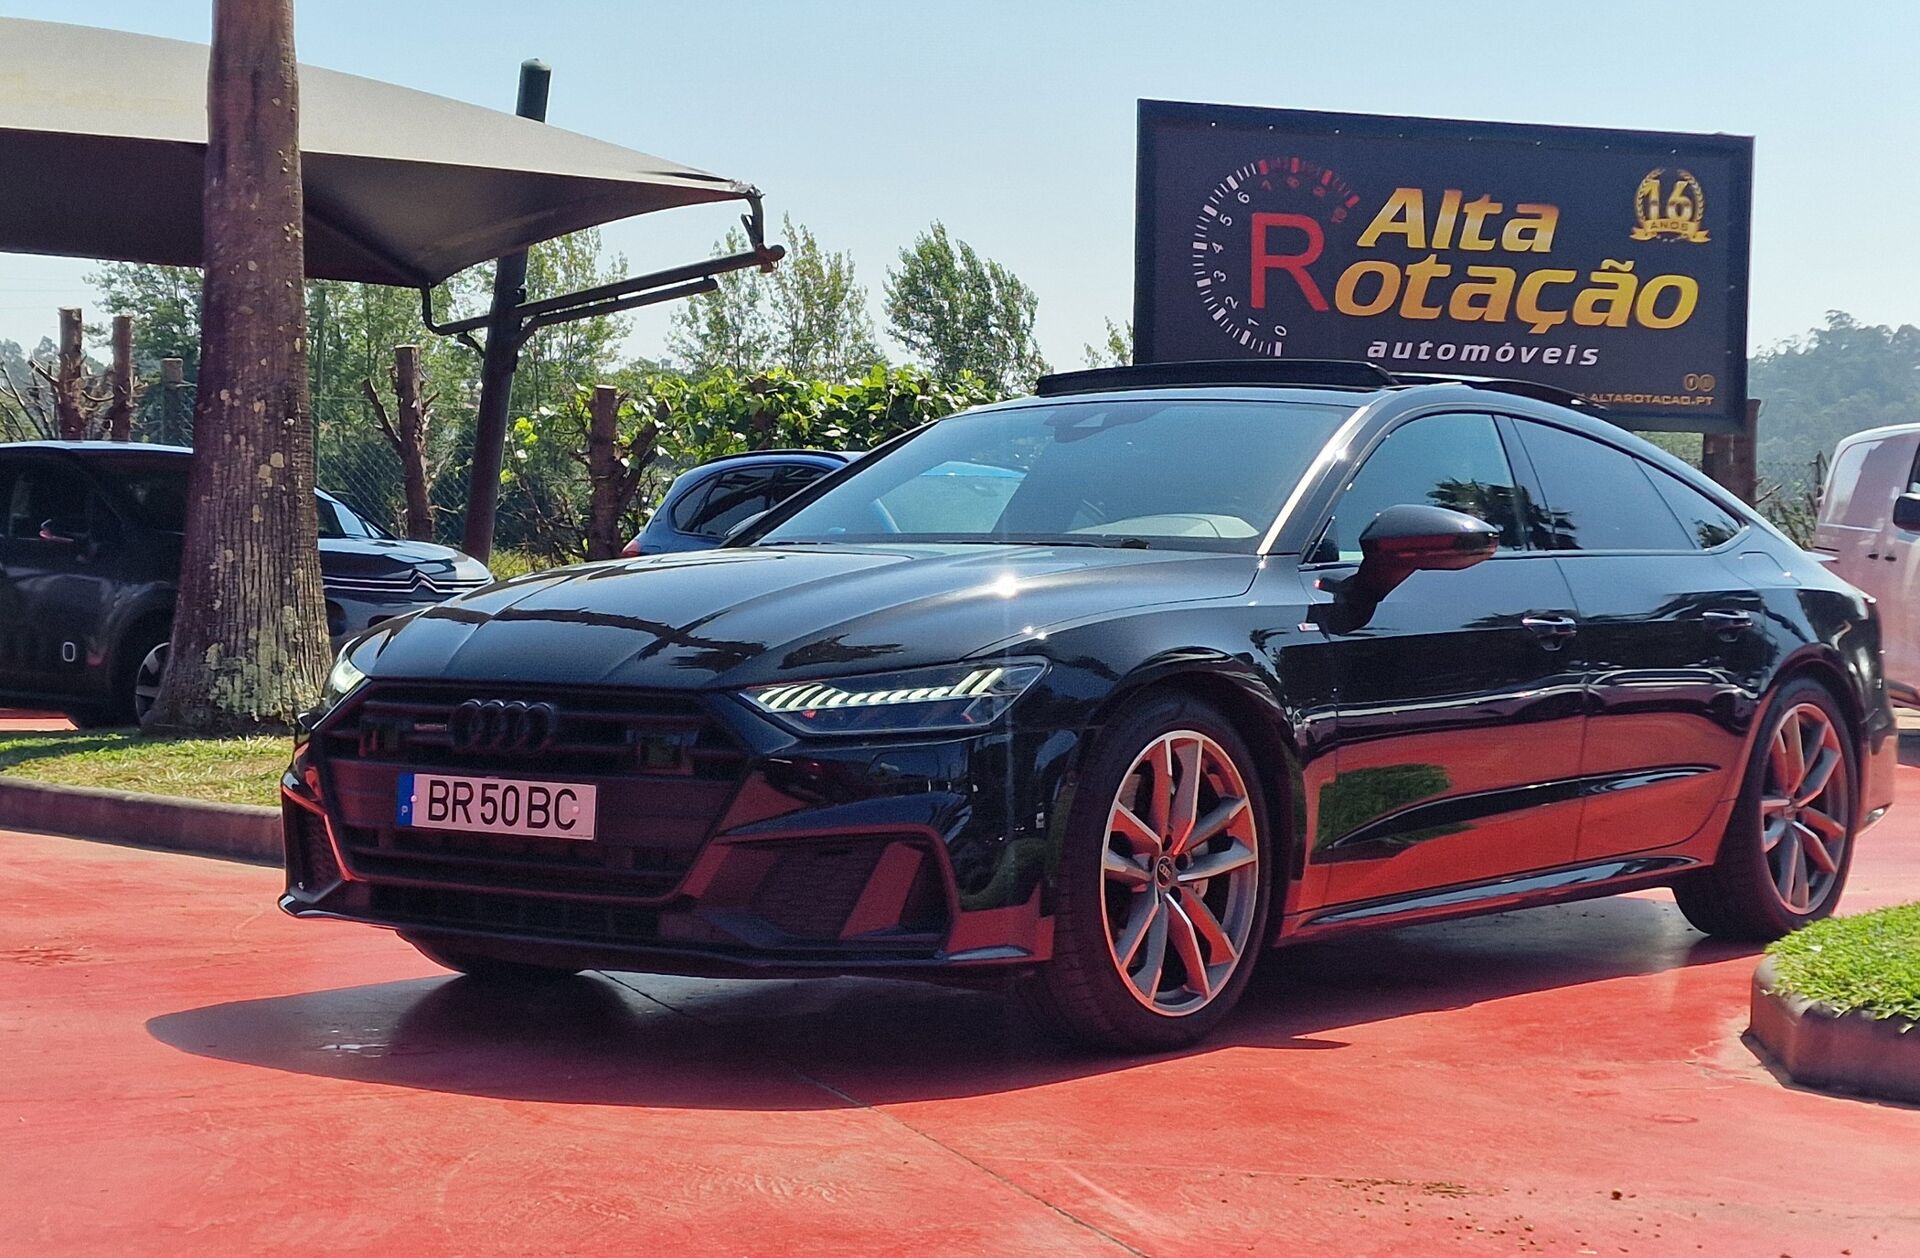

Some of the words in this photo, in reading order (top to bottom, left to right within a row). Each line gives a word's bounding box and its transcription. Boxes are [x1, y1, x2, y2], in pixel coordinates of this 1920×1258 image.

[1237, 191, 1250, 204] 6
[1640, 179, 1693, 220] 16
[1219, 213, 1233, 227] 5
[1356, 187, 1560, 253] Alta
[1650, 221, 1689, 231] ANOS
[1211, 241, 1224, 254] 4
[1213, 270, 1227, 282] 3
[1225, 296, 1239, 309] 2
[1247, 317, 1260, 327] 1
[1274, 325, 1287, 337] 0
[1367, 339, 1600, 366] automóveis
